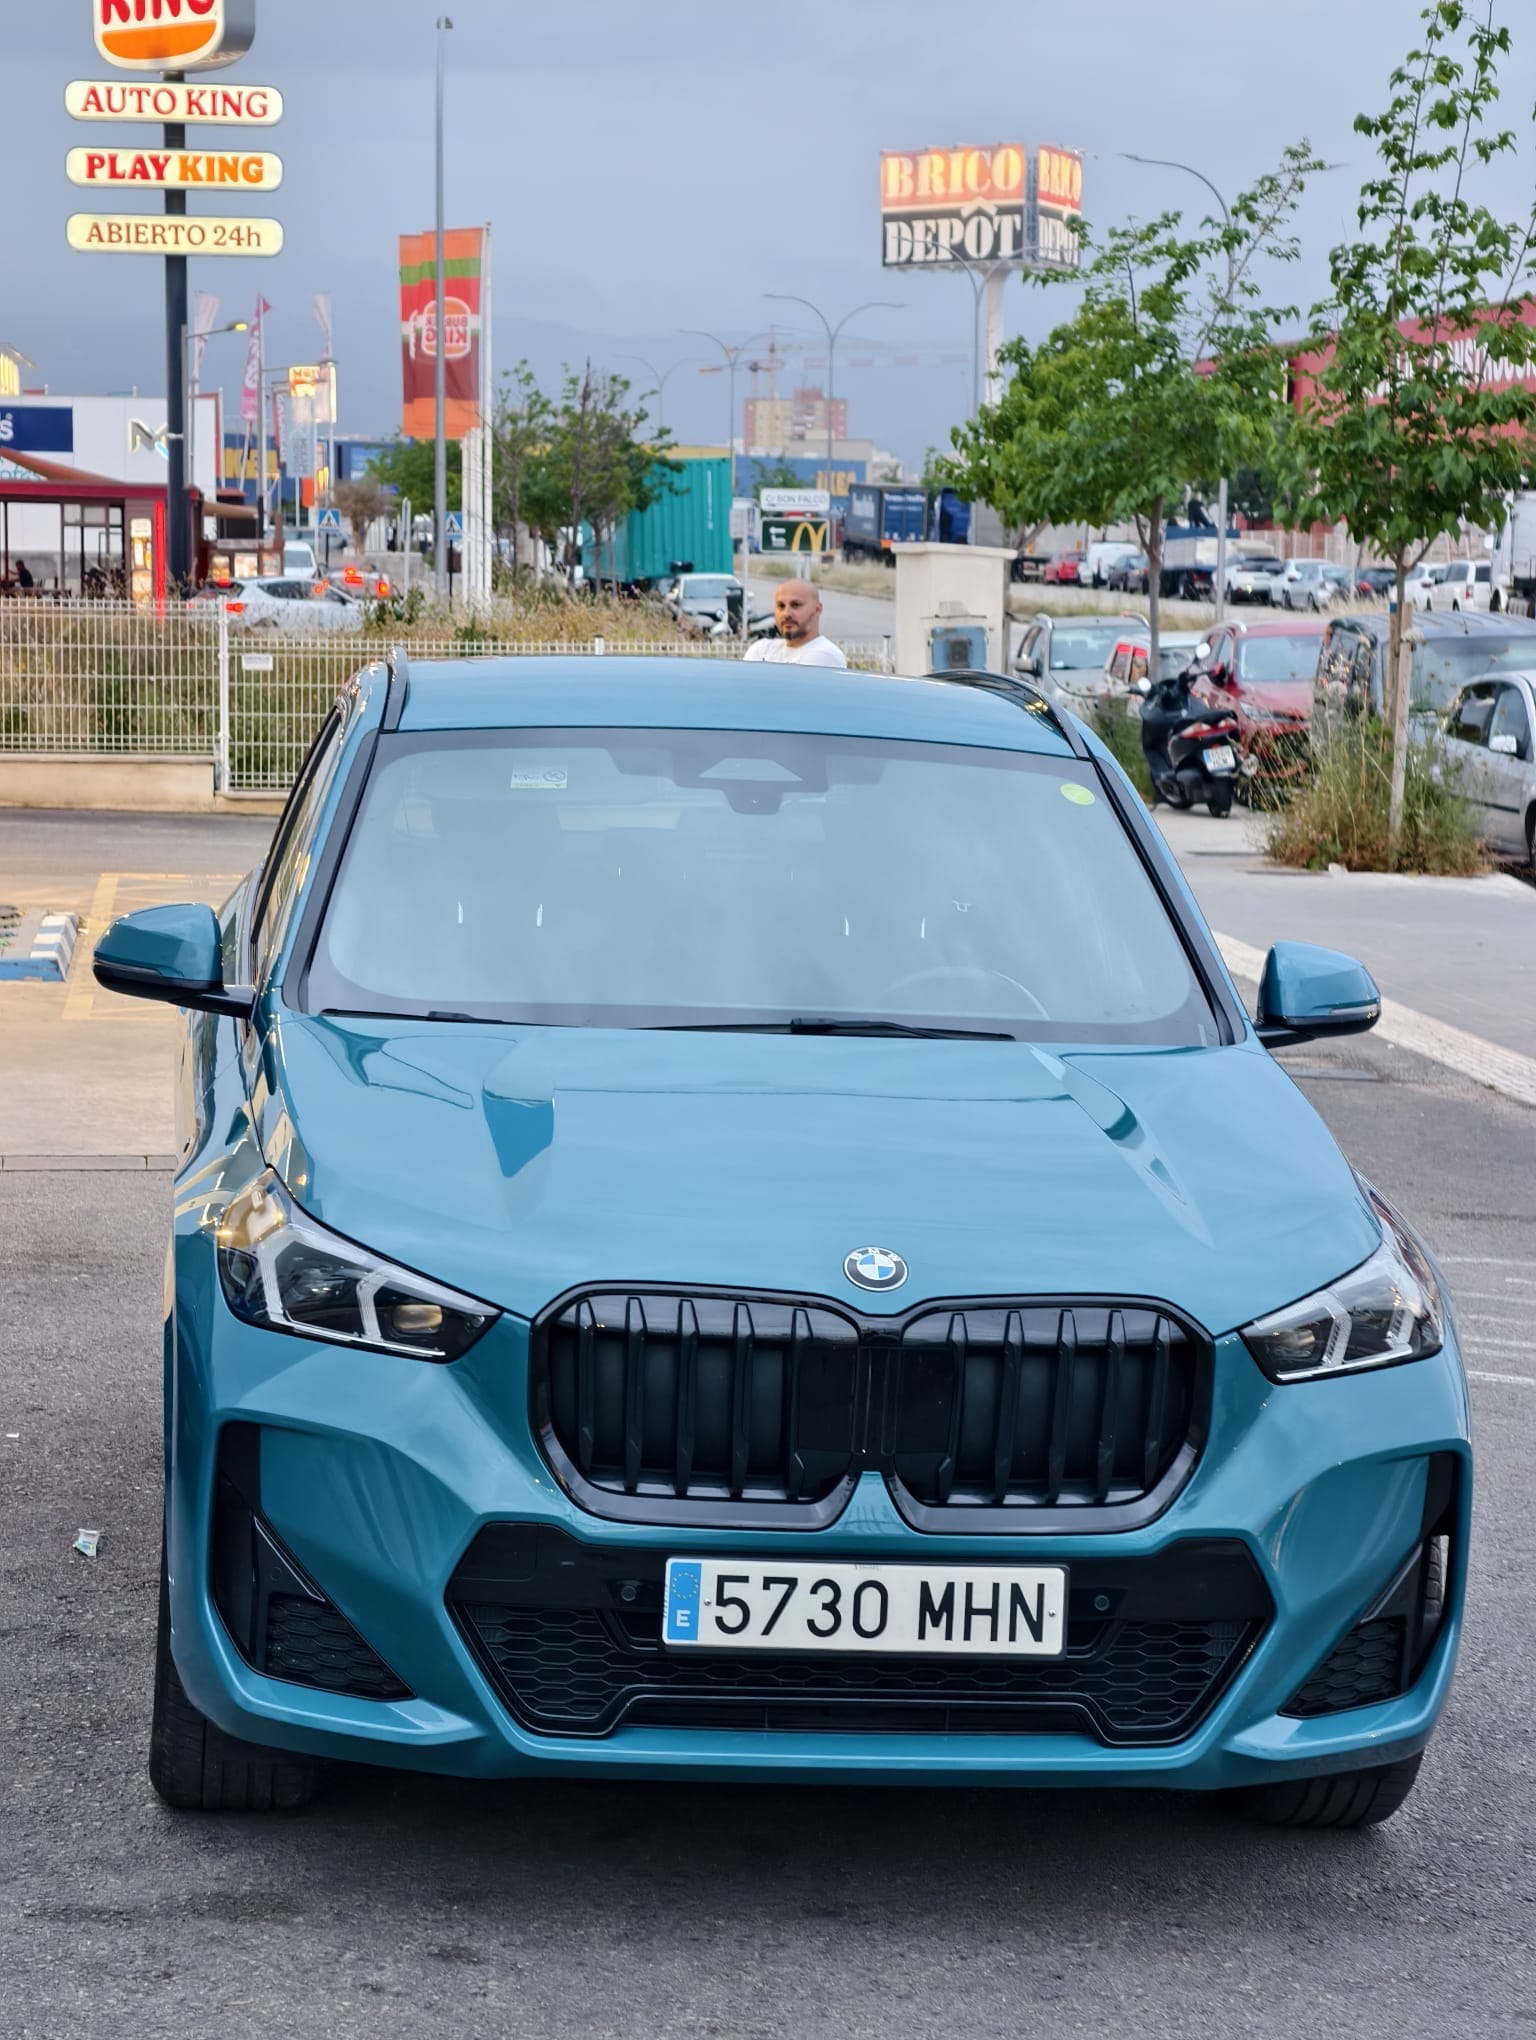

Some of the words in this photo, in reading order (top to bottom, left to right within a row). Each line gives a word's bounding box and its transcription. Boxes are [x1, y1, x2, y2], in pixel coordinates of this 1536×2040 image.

[81, 85, 176, 115] AUTO
[185, 89, 268, 118] KING
[86, 153, 172, 181] PLAY
[178, 155, 265, 184] KING
[884, 147, 1022, 199] BRICO
[1038, 148, 1082, 203] BRICO
[86, 222, 206, 246] ABIERTO
[213, 225, 262, 248] 24h
[676, 1609, 691, 1628] E
[714, 1574, 889, 1639] 5730
[917, 1580, 1046, 1643] MHN
